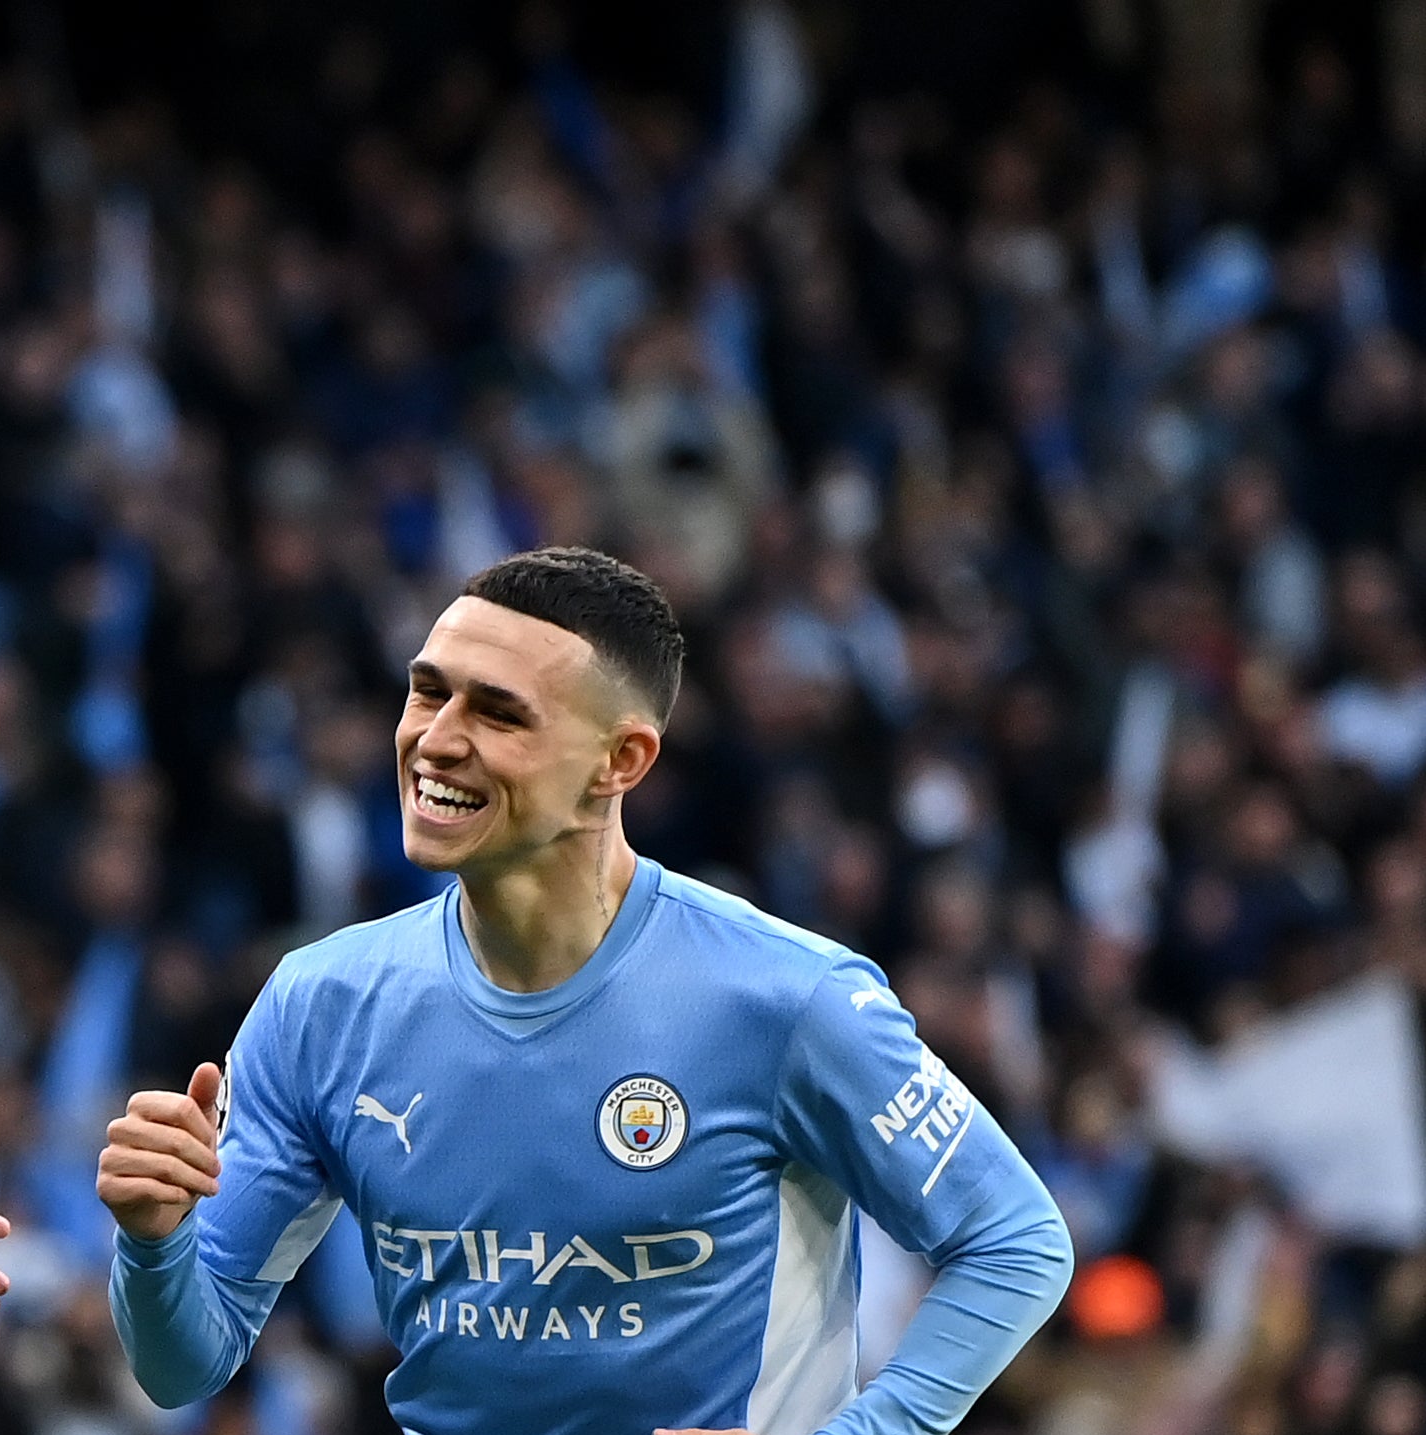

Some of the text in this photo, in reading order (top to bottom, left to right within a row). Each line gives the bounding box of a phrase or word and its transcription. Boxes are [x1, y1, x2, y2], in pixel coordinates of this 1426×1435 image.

[607, 1080, 680, 1113] MANCHESTER
[870, 1043, 946, 1145] NEXE
[627, 1153, 655, 1164] CITY
[371, 1221, 714, 1285] ETIHAD
[415, 1295, 643, 1340] AIRWAYS
